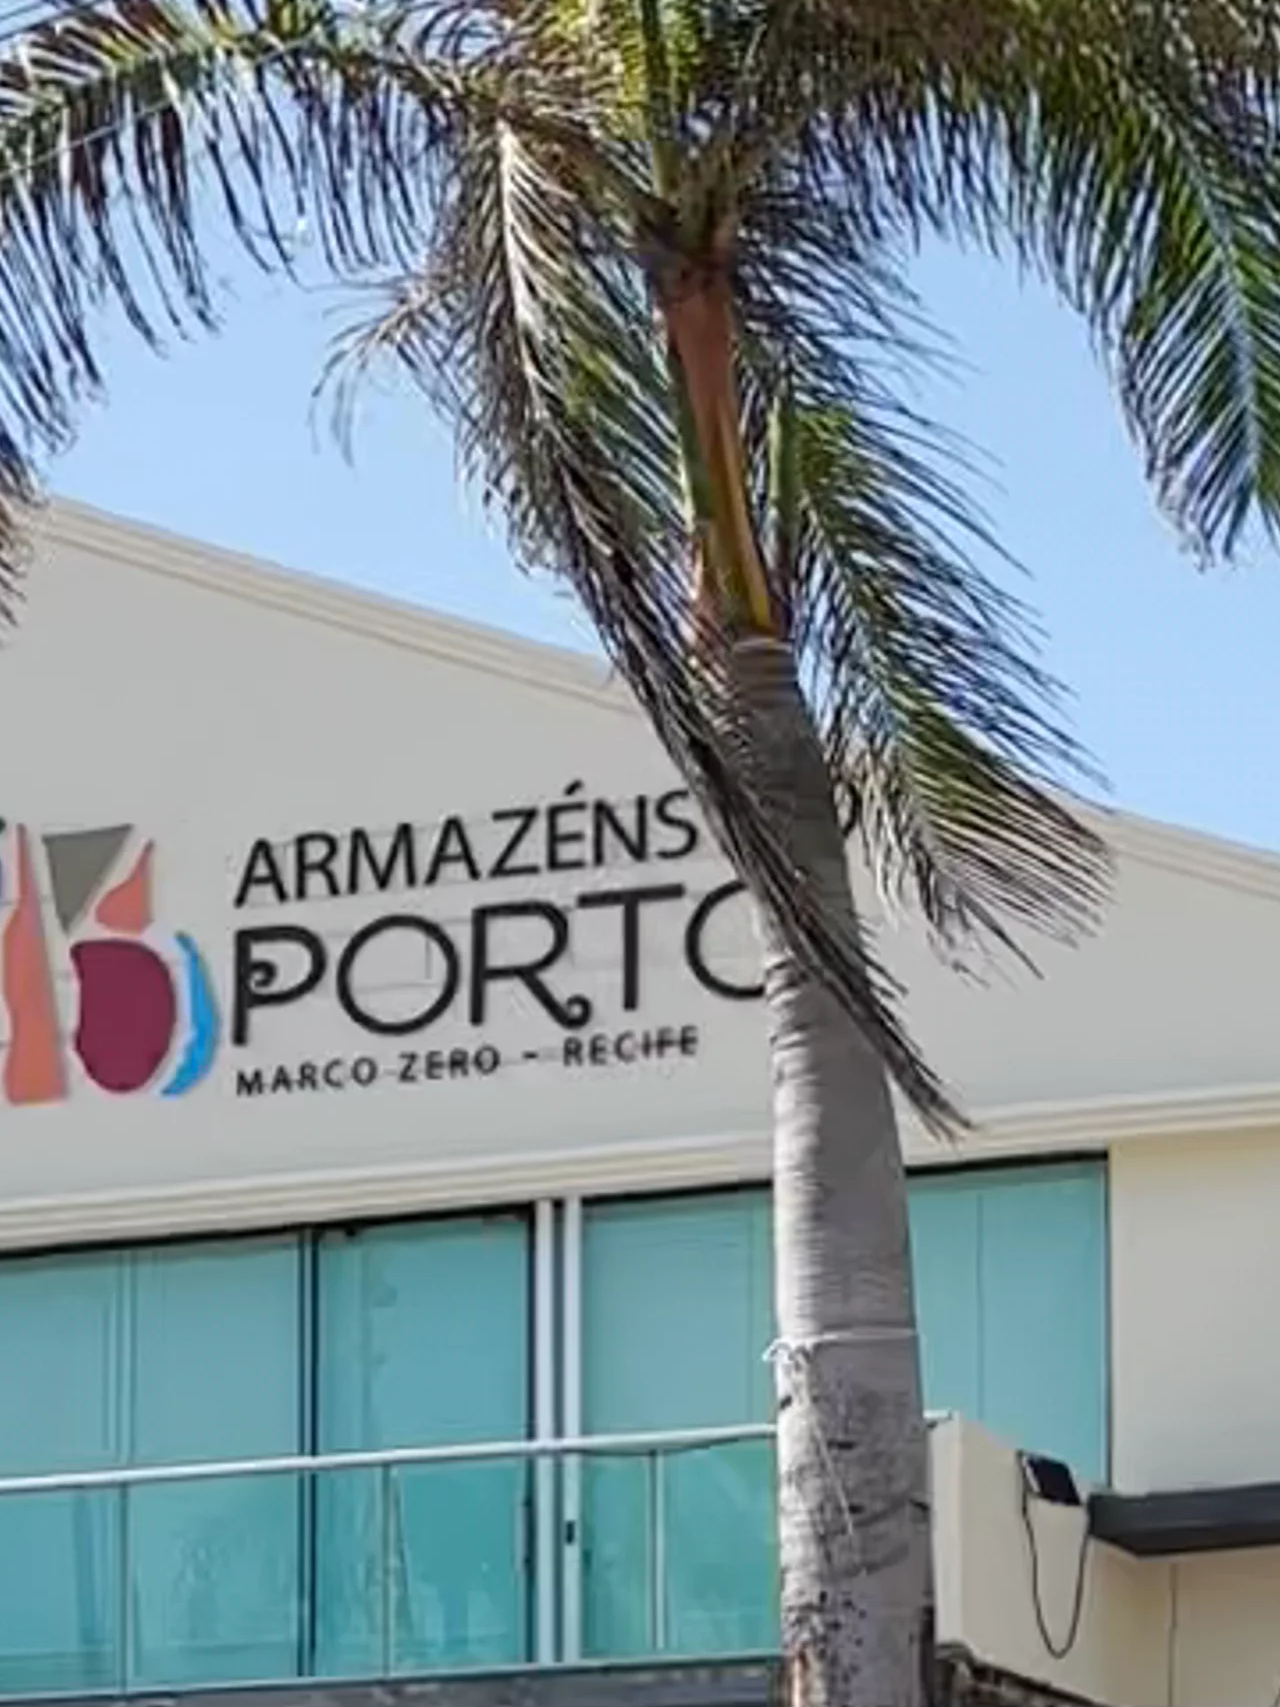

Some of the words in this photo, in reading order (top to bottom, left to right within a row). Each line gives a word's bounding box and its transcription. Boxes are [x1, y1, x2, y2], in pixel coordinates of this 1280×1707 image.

[233, 780, 699, 909] ARMAZÉNS
[235, 1057, 378, 1096] MARCO
[397, 1045, 502, 1083] ZERO
[562, 1025, 699, 1067] RECIFE
